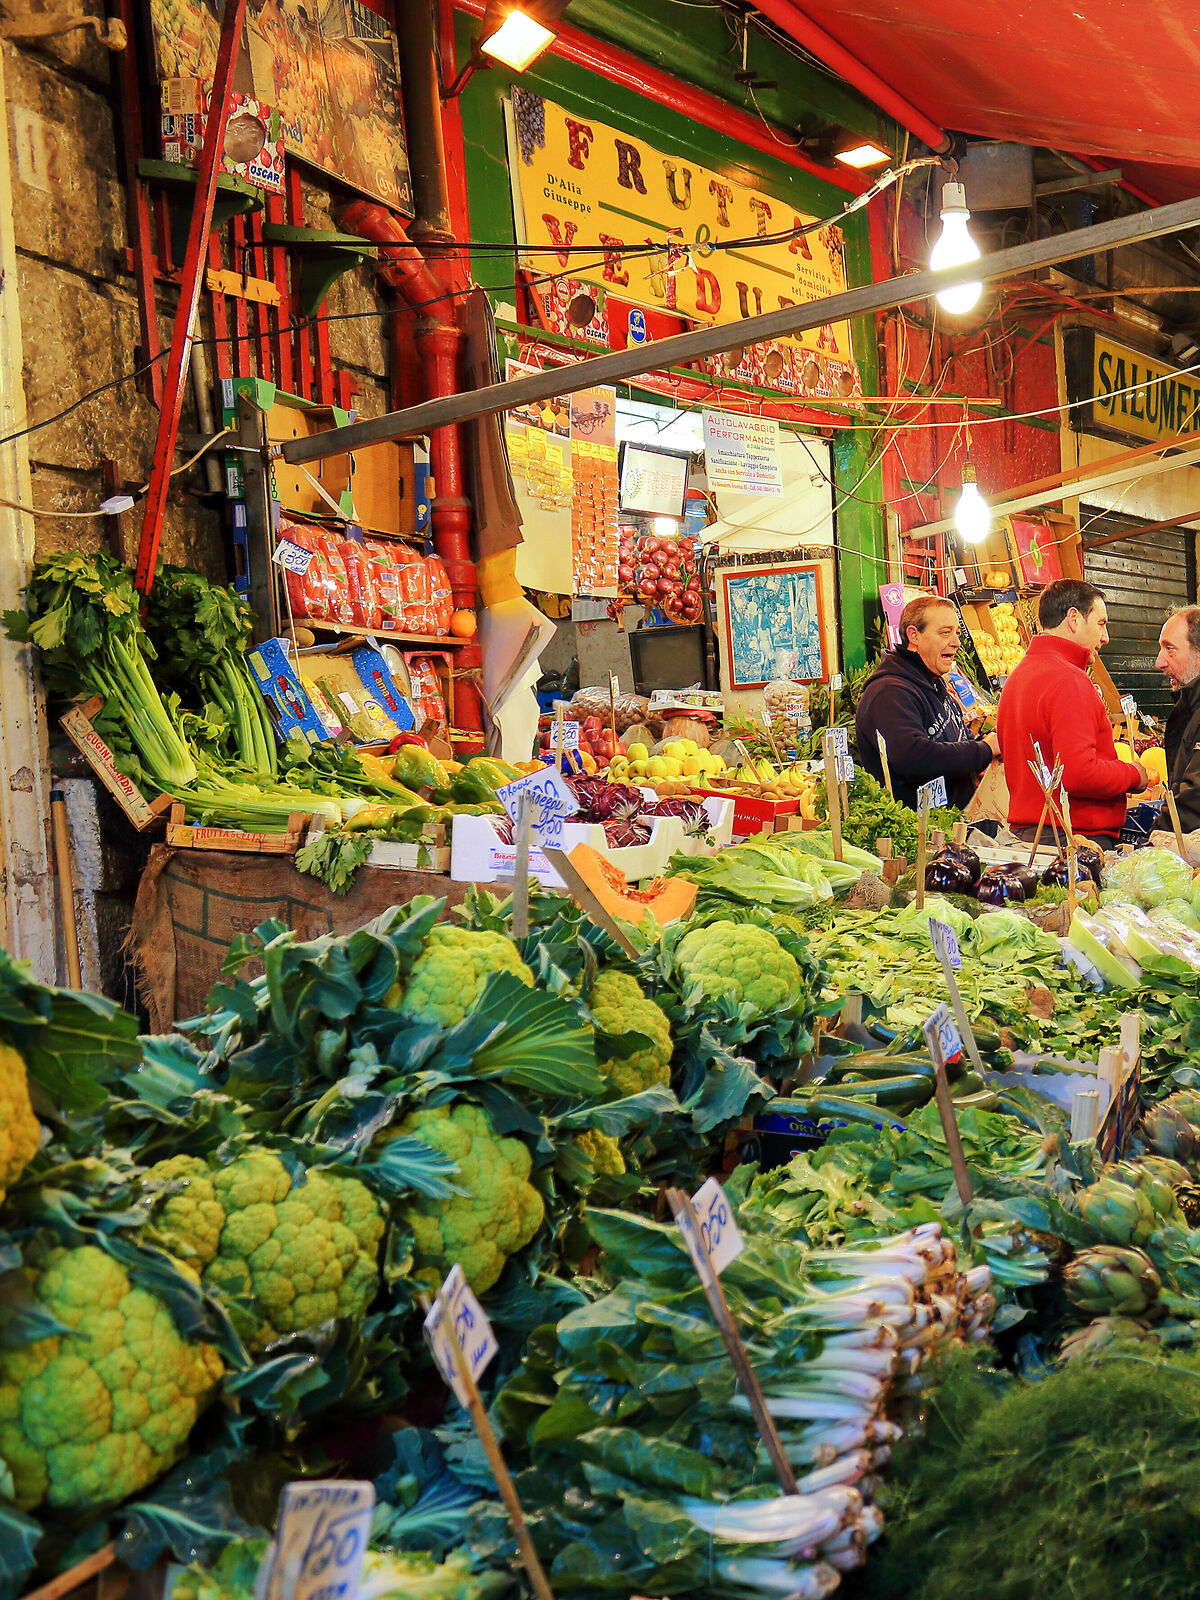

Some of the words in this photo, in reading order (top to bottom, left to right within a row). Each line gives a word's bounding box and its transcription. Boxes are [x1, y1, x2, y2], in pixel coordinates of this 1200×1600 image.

[250, 165, 280, 183] OSCAR
[547, 173, 582, 196] D'Alia
[565, 117, 812, 260] FRUTTA
[543, 187, 592, 213] Giuseppe
[797, 262, 826, 282] Servizio
[799, 276, 832, 296] domicilio
[586, 328, 607, 341] OSCAR
[707, 415, 775, 434] AUTOLAVAGGIO
[709, 427, 775, 446] PERFORMANCE
[86, 732, 112, 762] CUGINI
[195, 827, 230, 841] FRUTTA
